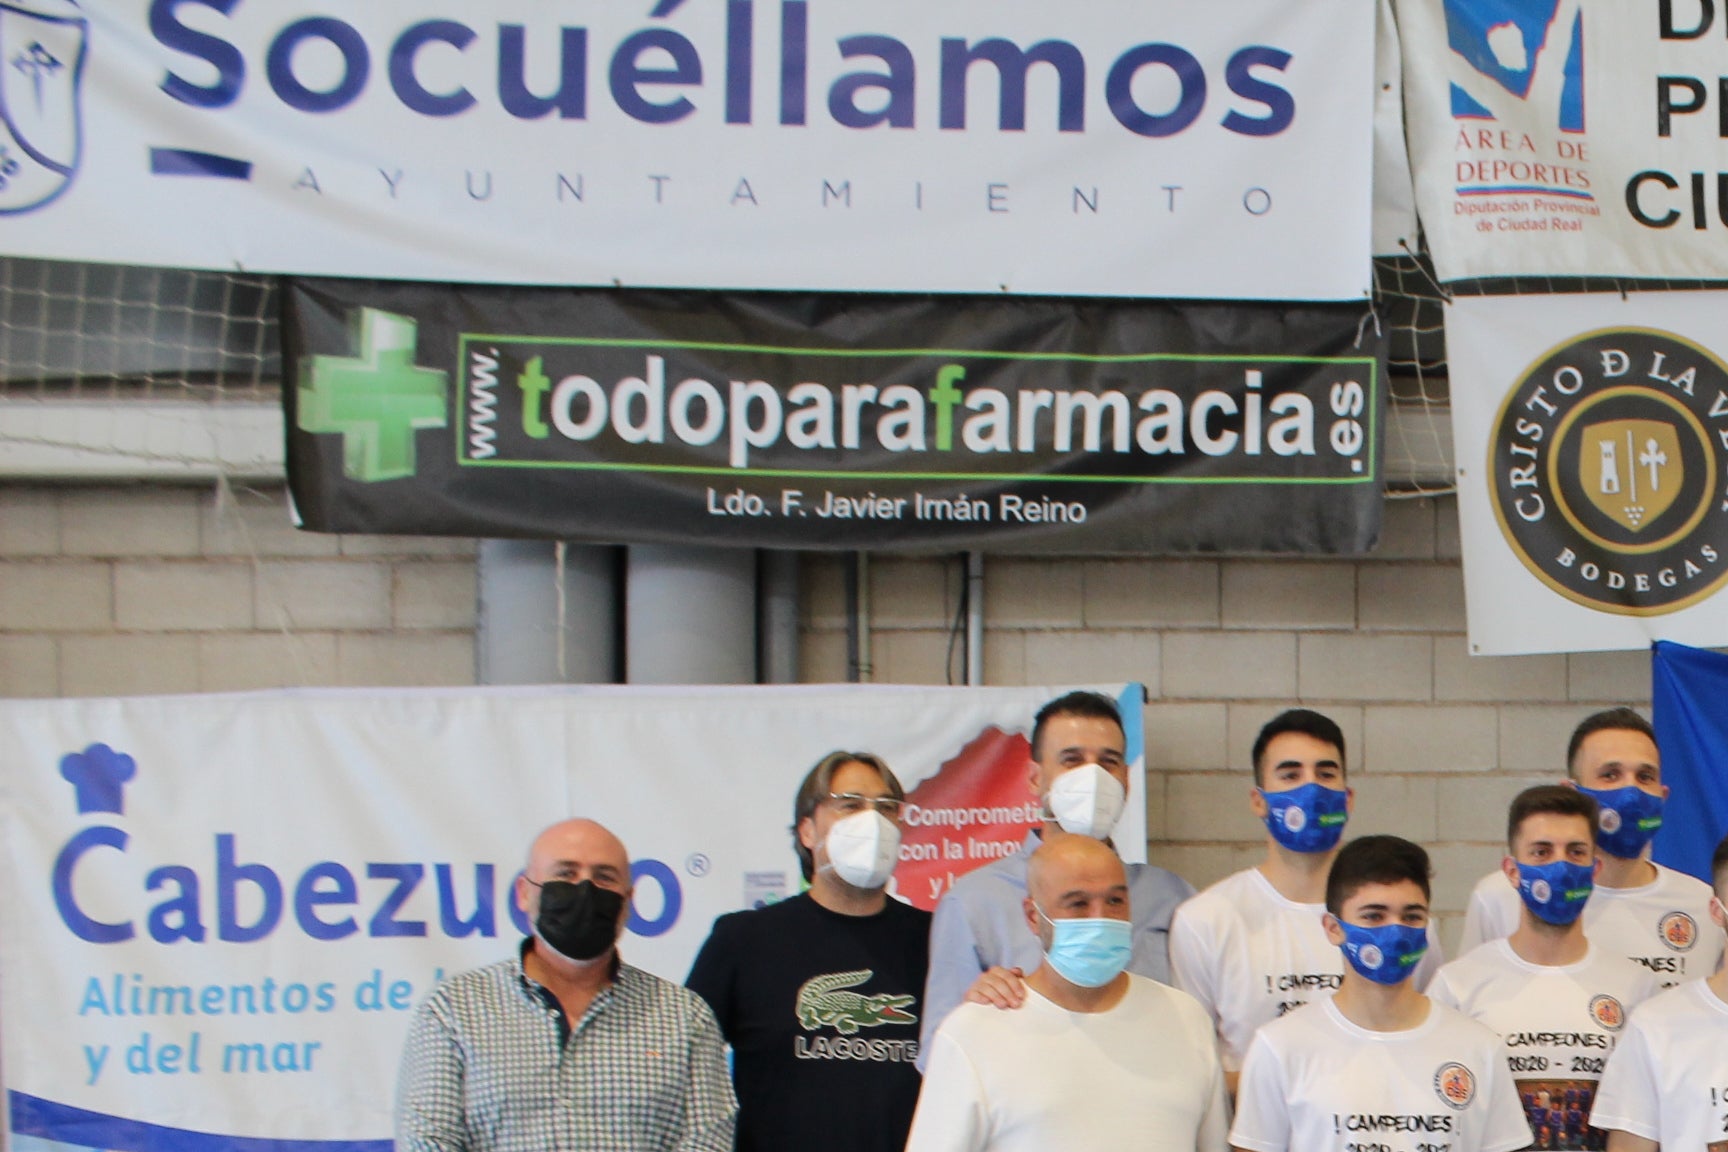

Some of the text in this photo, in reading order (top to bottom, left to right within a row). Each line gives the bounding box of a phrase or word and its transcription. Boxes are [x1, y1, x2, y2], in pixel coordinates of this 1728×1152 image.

[147, 0, 1296, 138] Socuéllamos
[1557, 140, 1590, 162] DE
[1456, 159, 1592, 189] DEPORTES
[295, 168, 1273, 217] AYUNTAMIENTO
[1533, 199, 1601, 216] Provincial
[1476, 217, 1583, 232] de Ciudad Real
[1509, 365, 1583, 522] CRISTO
[1648, 352, 1697, 397] LA
[707, 488, 1087, 525] Ldo. F. Javier Imán Reino
[1556, 544, 1719, 592] BODEGAS
[899, 843, 938, 861] con
[942, 837, 963, 859] la
[52, 825, 683, 945] Cabezuo
[80, 971, 336, 1016] Alimentos
[354, 967, 413, 1012] de
[795, 1035, 918, 1063] LACOSTE
[1506, 1032, 1608, 1049] CAMPEONES
[83, 1032, 322, 1086] y del mar
[1346, 1114, 1453, 1132] CAMPEONES
